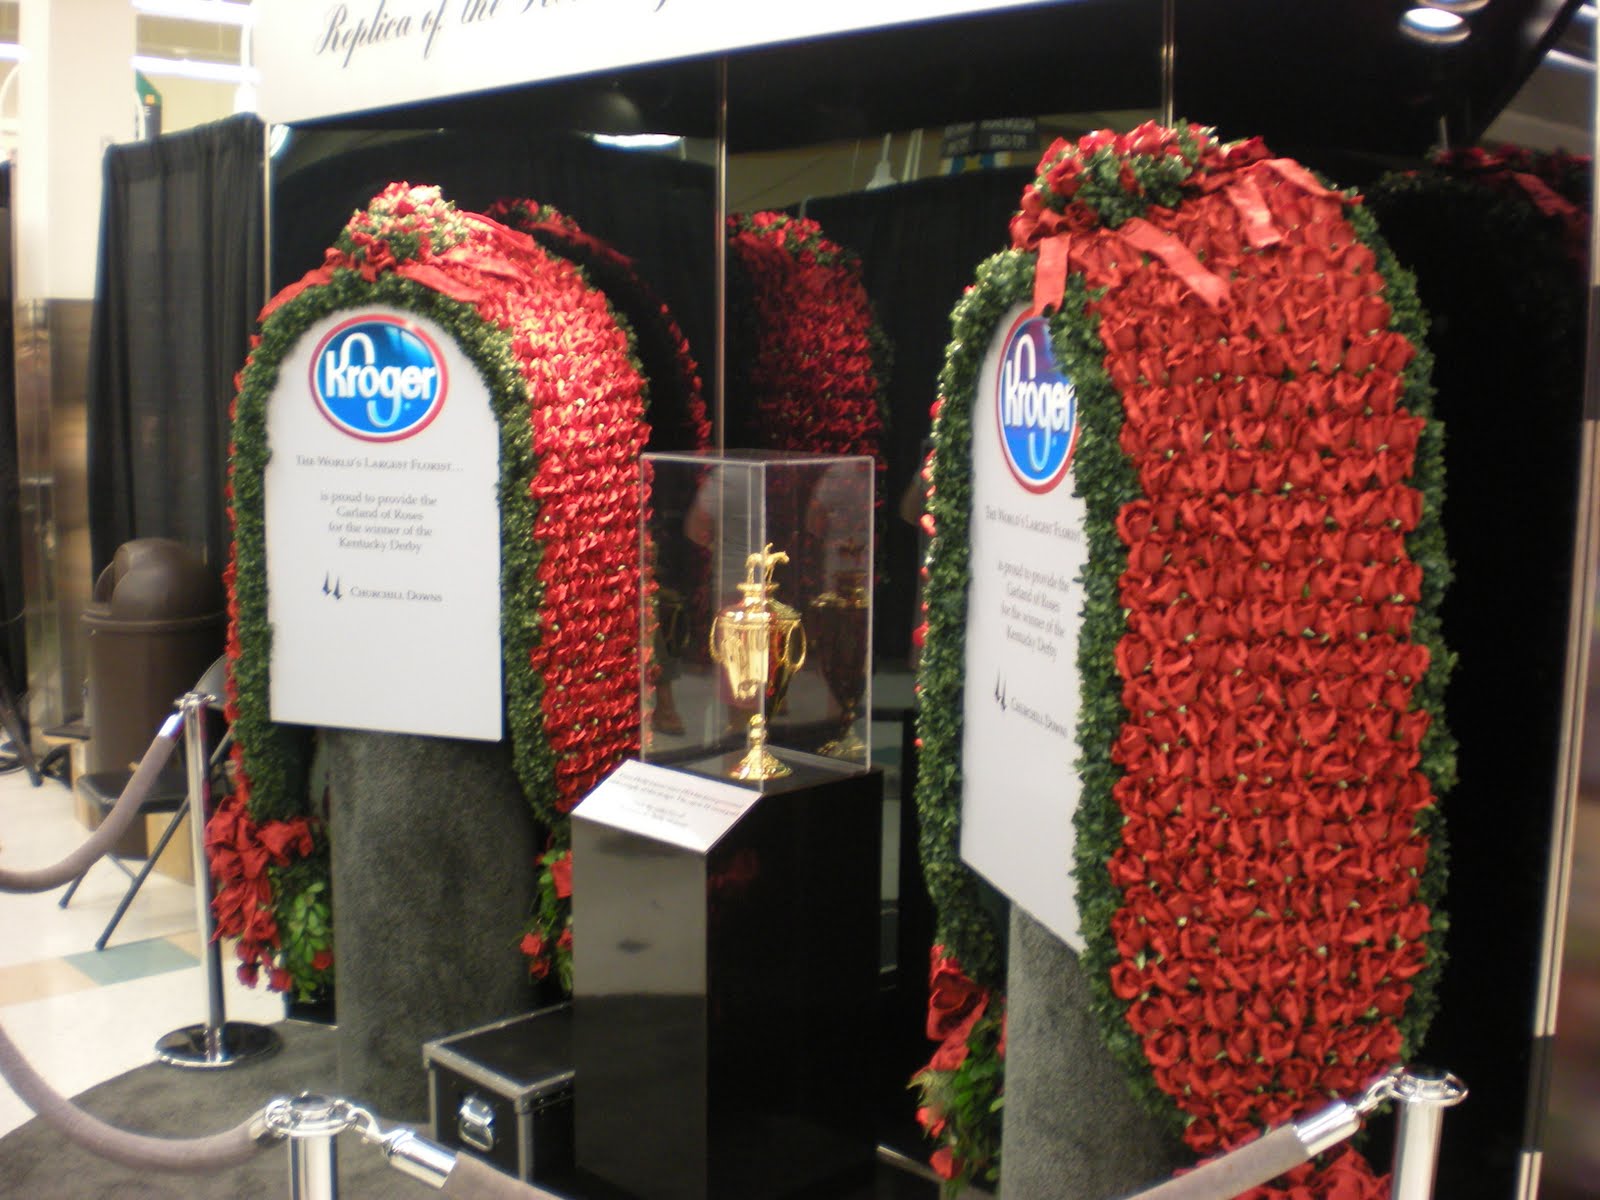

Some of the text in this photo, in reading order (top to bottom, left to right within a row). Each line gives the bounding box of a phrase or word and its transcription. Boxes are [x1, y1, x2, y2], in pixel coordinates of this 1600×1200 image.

[314, 0, 412, 68] Replica
[421, 0, 444, 60] of
[325, 332, 436, 428] Kroger
[1004, 333, 1075, 472] Kroger
[331, 491, 362, 504] proud
[364, 493, 376, 503] to
[378, 493, 418, 506] provide
[420, 494, 438, 506] the
[336, 506, 424, 521] Garland of Roses
[328, 520, 433, 537] for the winner of the
[338, 536, 423, 555] Kentucky Derby
